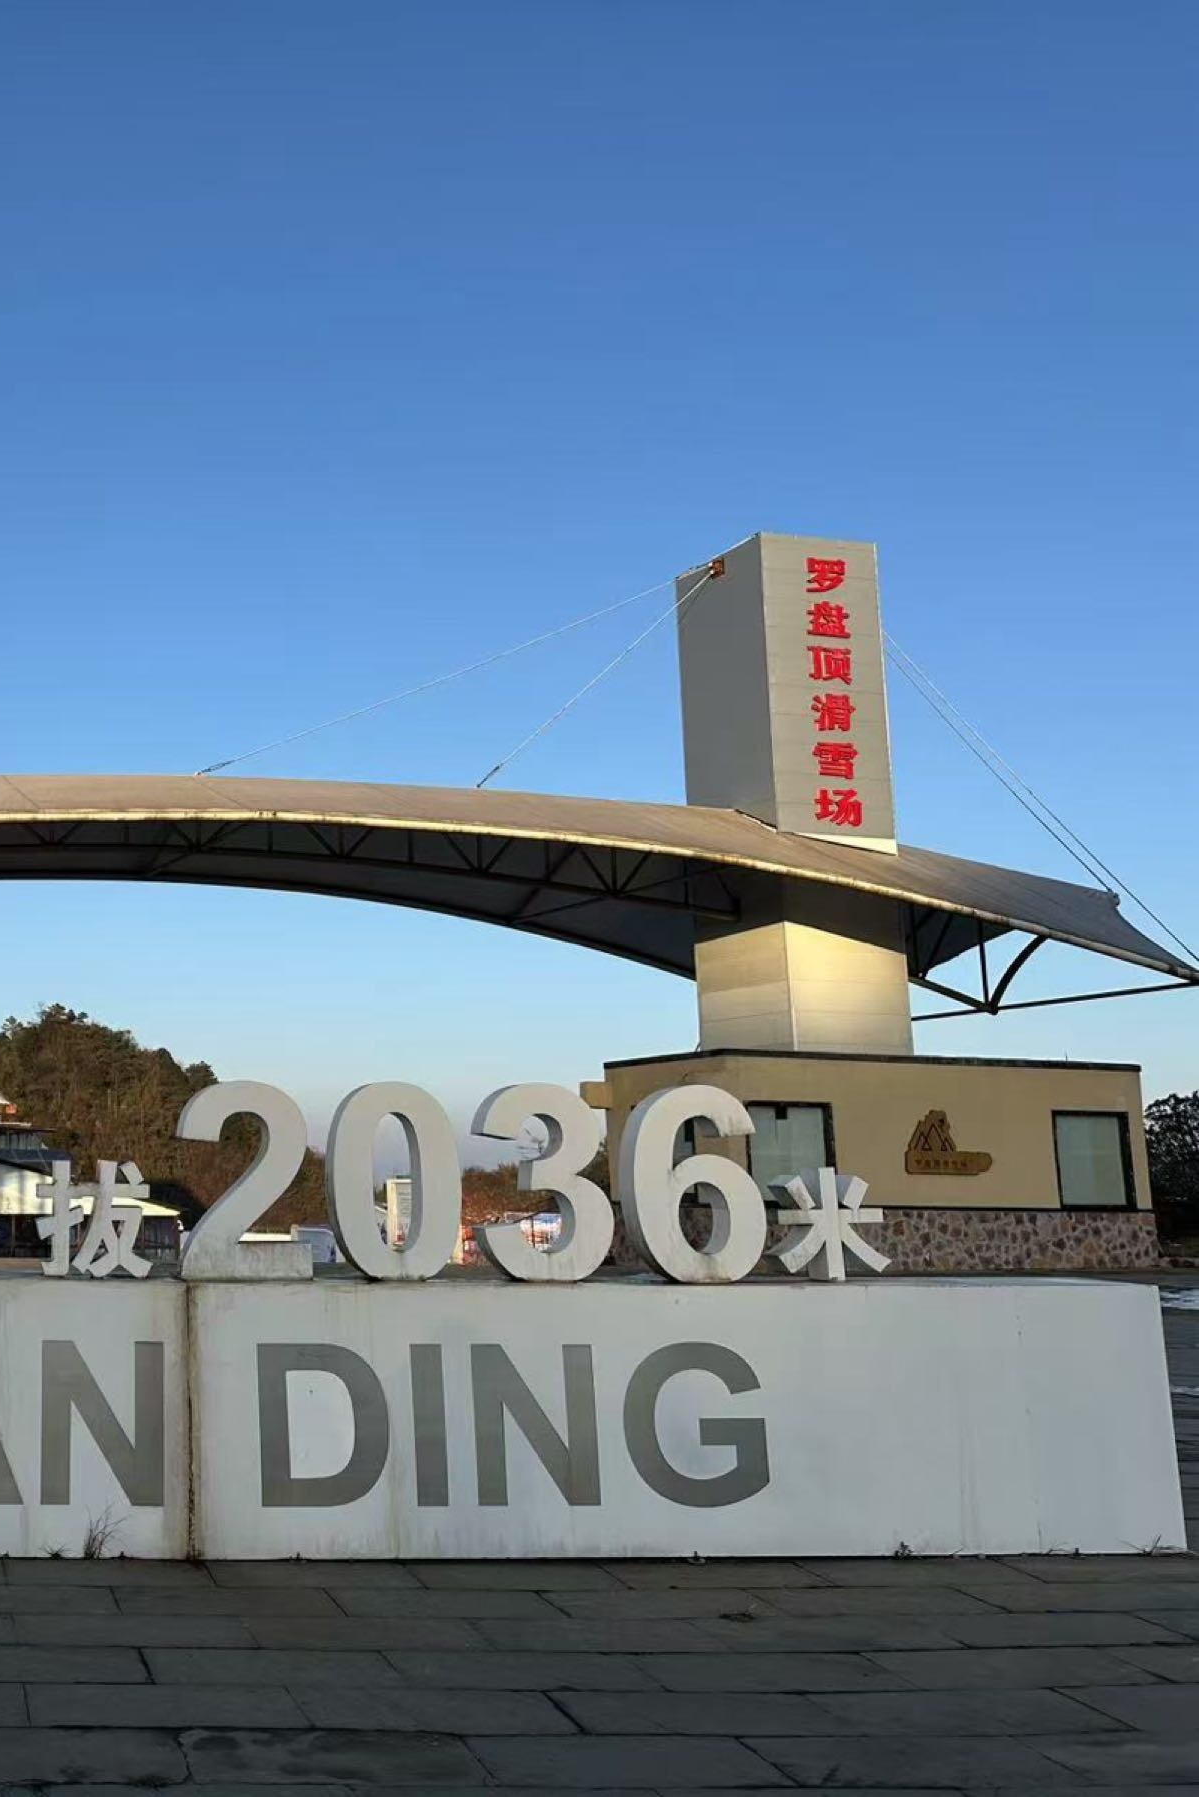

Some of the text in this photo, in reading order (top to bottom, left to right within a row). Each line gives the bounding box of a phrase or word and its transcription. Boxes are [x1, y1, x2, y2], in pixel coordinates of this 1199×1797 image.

[806, 557, 863, 827] 罗盘顶滑雪场
[256, 1341, 770, 1508] DING
